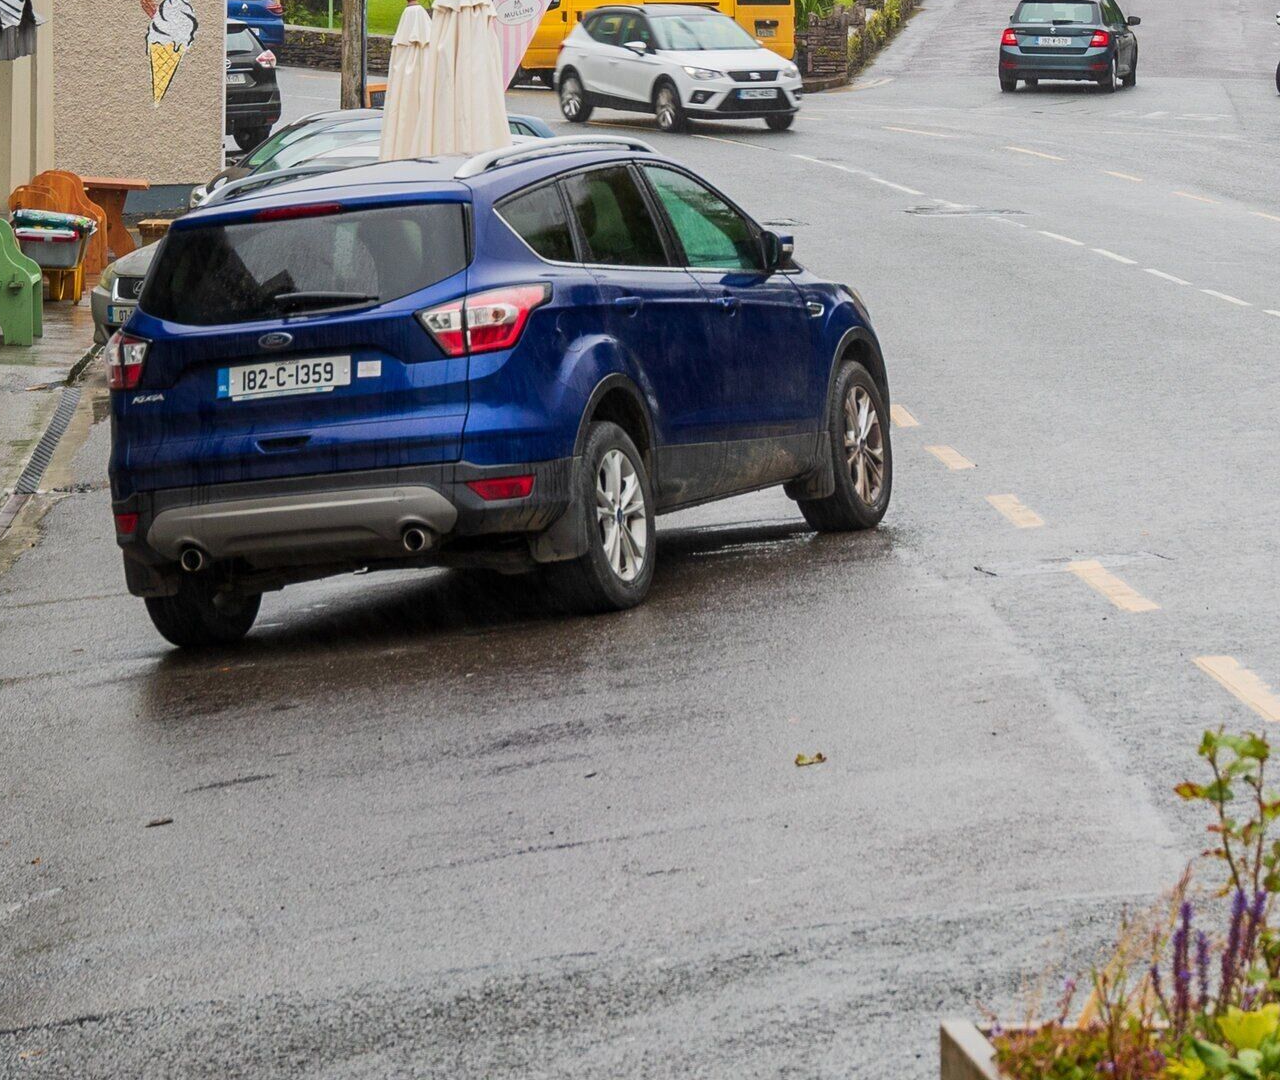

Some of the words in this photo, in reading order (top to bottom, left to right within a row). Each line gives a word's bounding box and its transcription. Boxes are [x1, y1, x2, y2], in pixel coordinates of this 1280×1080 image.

[504, 7, 534, 18] MULLINS
[242, 361, 334, 392] 182-C-1359
[131, 393, 166, 405] KUGA
